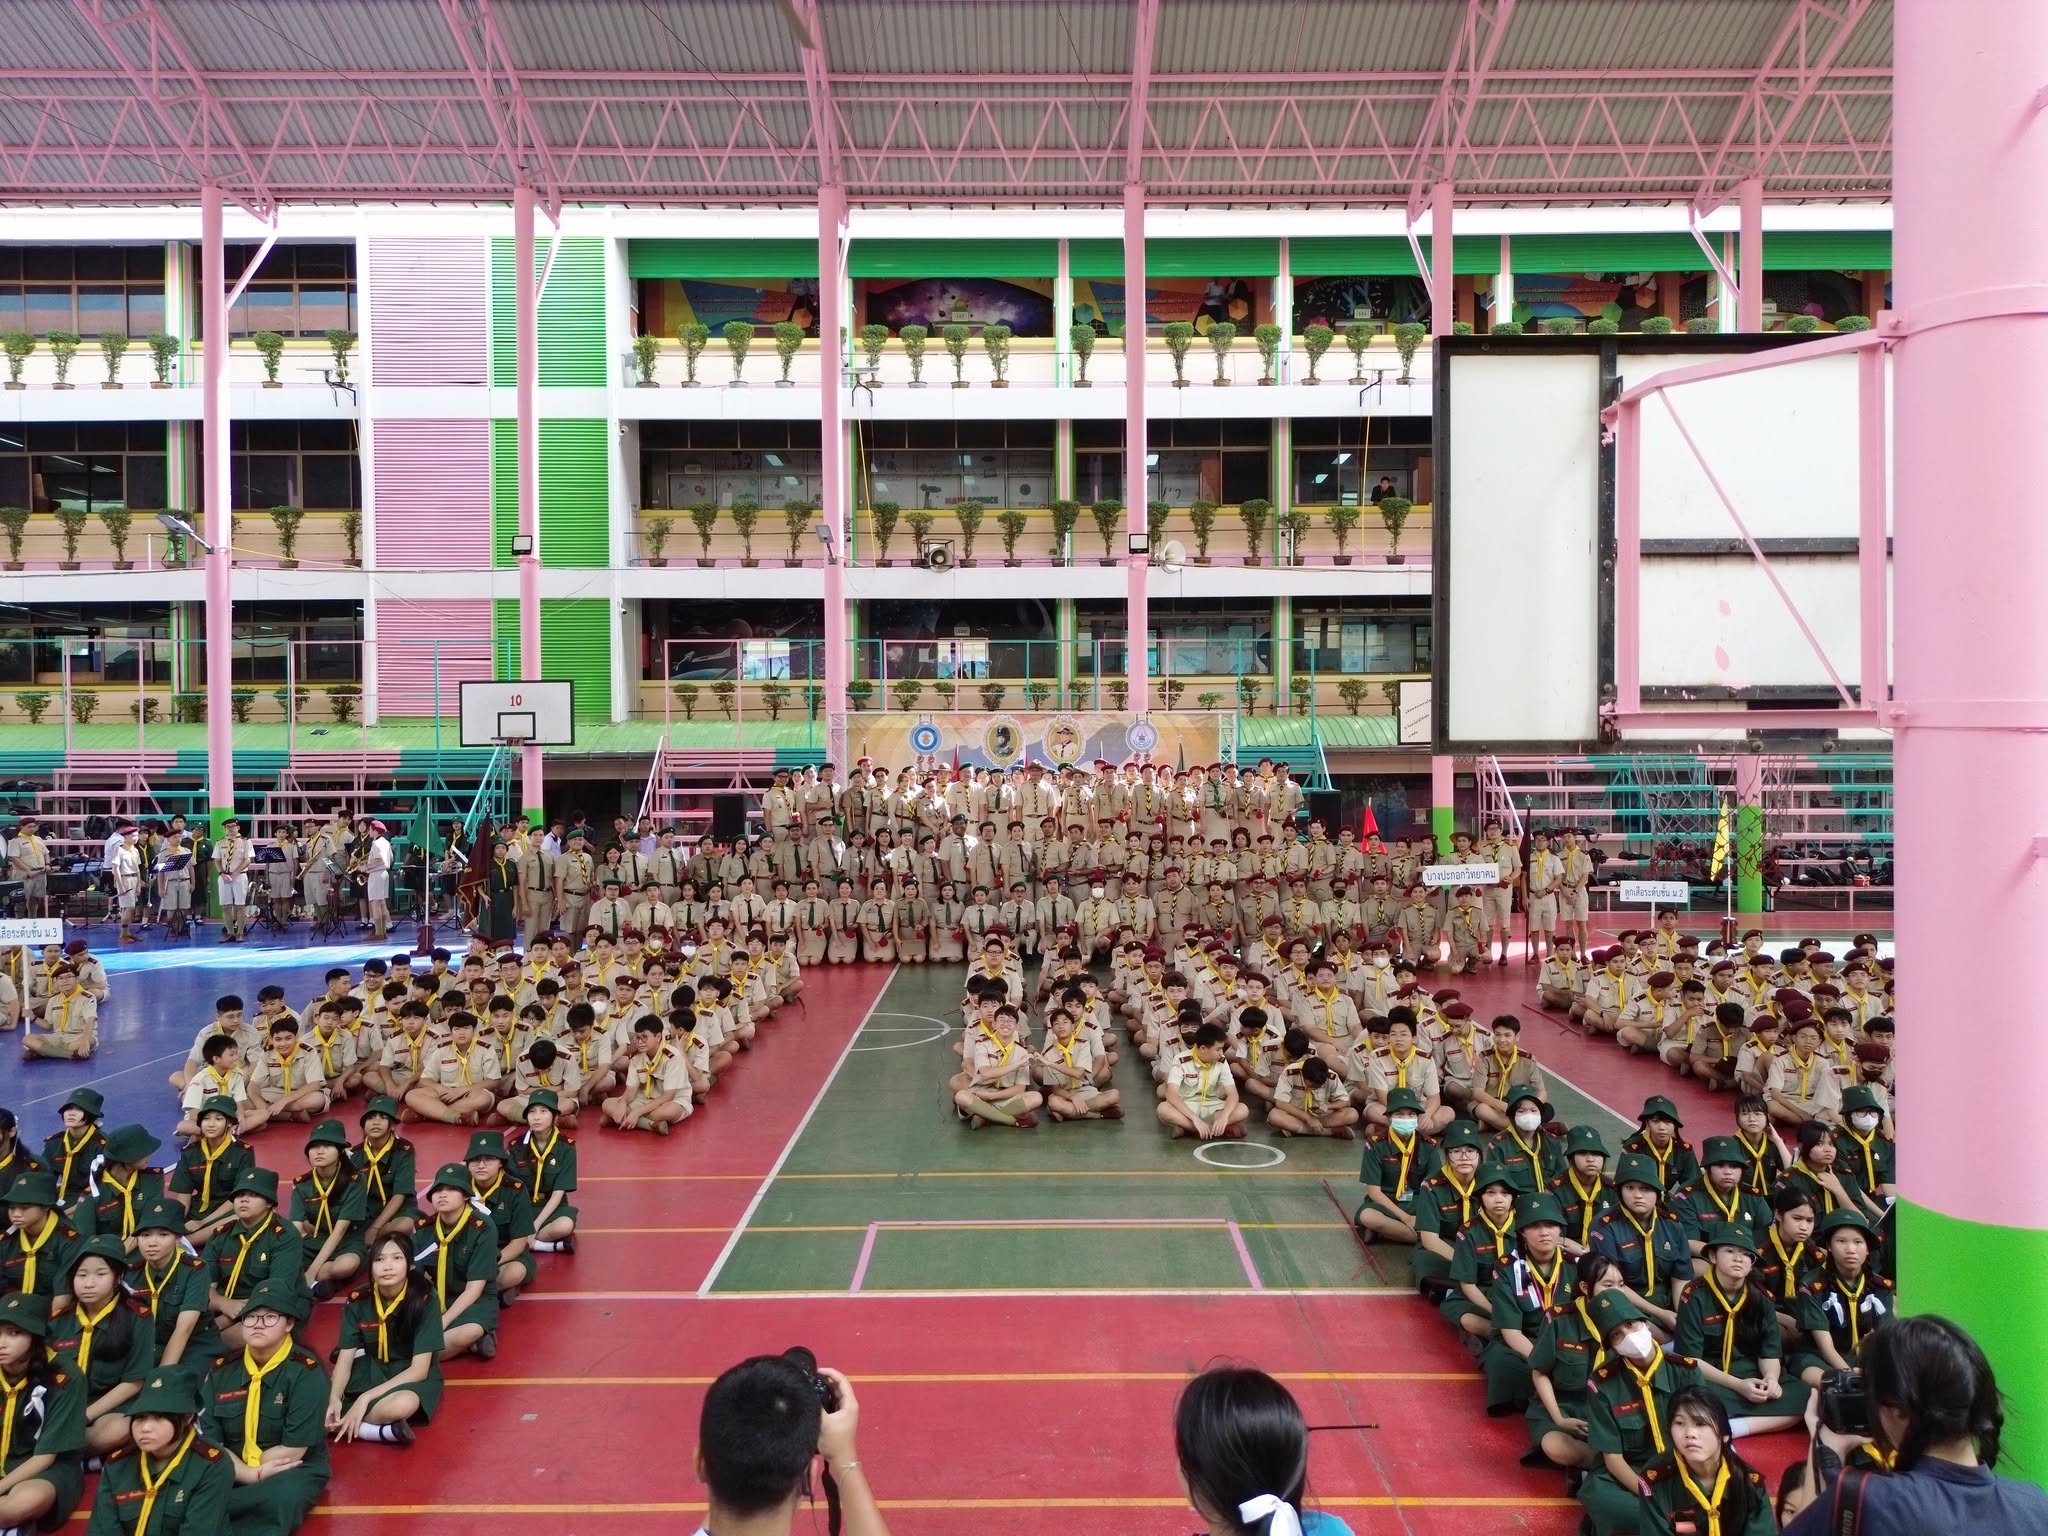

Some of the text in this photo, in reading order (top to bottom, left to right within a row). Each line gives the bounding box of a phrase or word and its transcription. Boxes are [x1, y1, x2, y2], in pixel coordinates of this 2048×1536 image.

[510, 694, 522, 706] 10
[1426, 868, 1496, 881] บางปะกอกวิทยาคม
[0, 921, 57, 938] สือระดับชั้น ม.3
